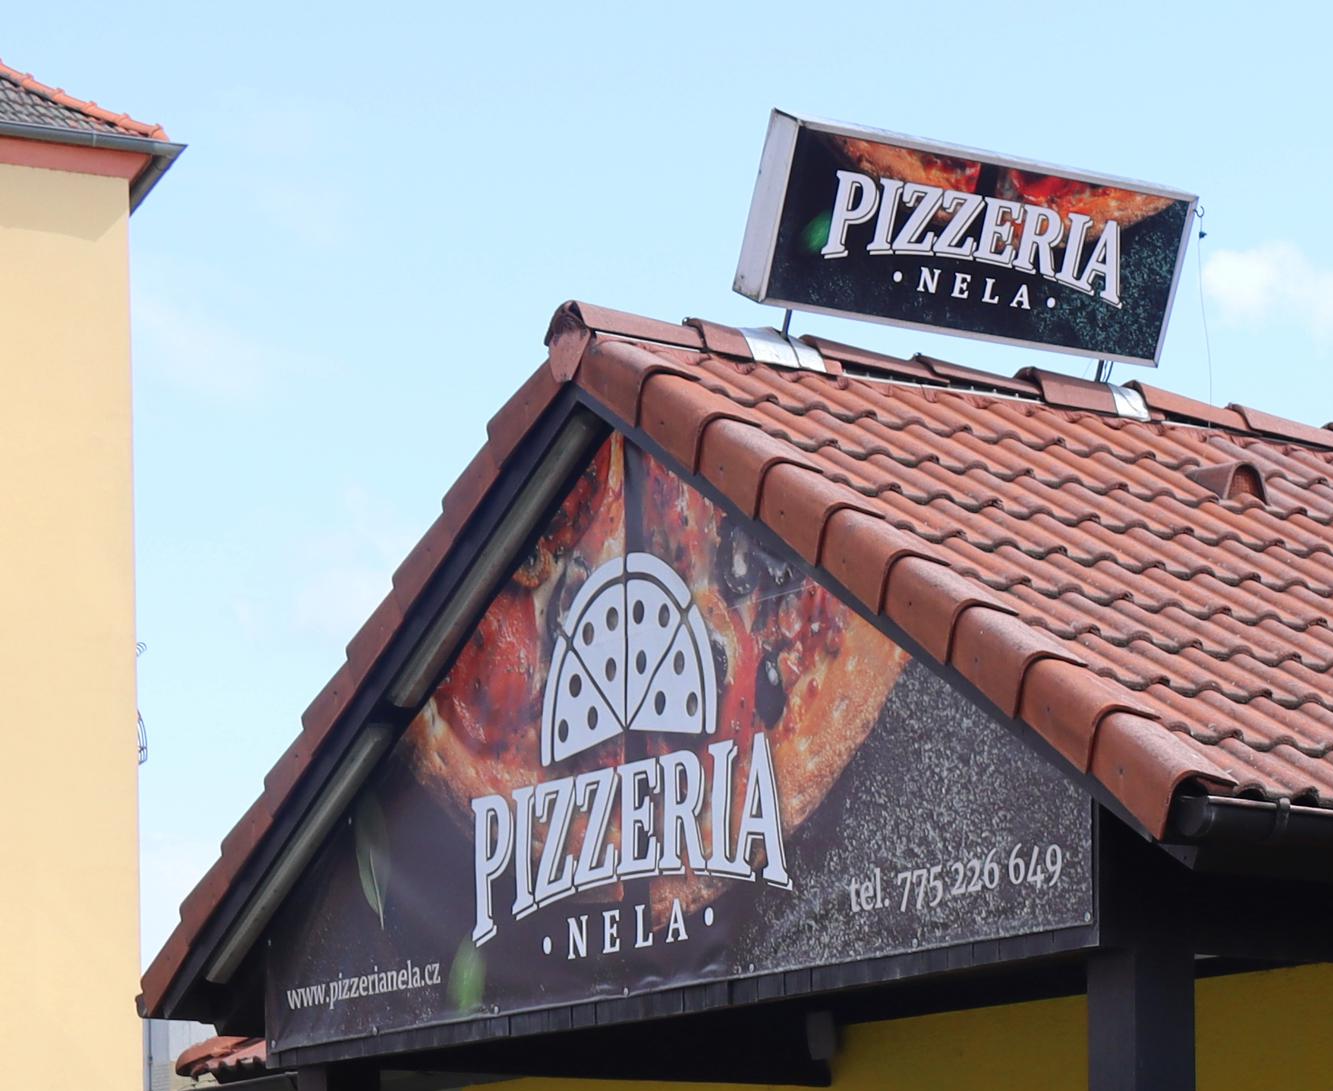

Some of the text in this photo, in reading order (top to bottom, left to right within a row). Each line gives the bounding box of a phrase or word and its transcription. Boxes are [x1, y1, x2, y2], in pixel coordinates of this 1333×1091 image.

[821, 169, 1122, 309] PIZZERIA
[916, 266, 1032, 309] NELA
[471, 732, 793, 947] PIZZERIA
[849, 842, 1063, 912] tel. 775 226 649
[567, 898, 689, 959] NELA
[286, 959, 441, 1010] www.pizzerianela.cz
